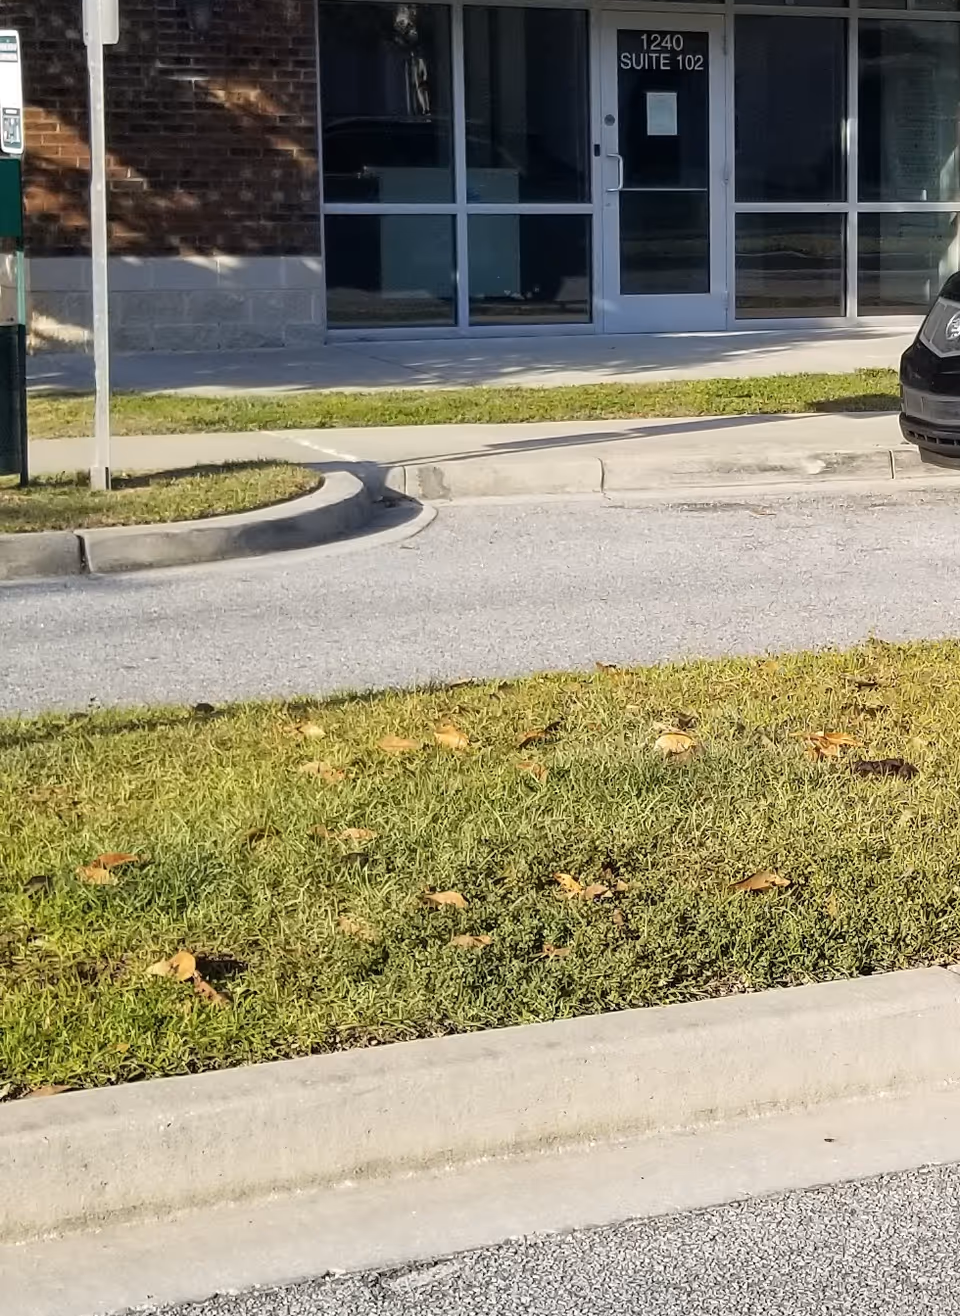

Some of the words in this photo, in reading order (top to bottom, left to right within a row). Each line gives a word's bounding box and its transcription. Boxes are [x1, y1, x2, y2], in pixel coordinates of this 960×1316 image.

[640, 33, 684, 52] 1240
[620, 52, 671, 70] SUITE
[676, 54, 704, 71] 102
